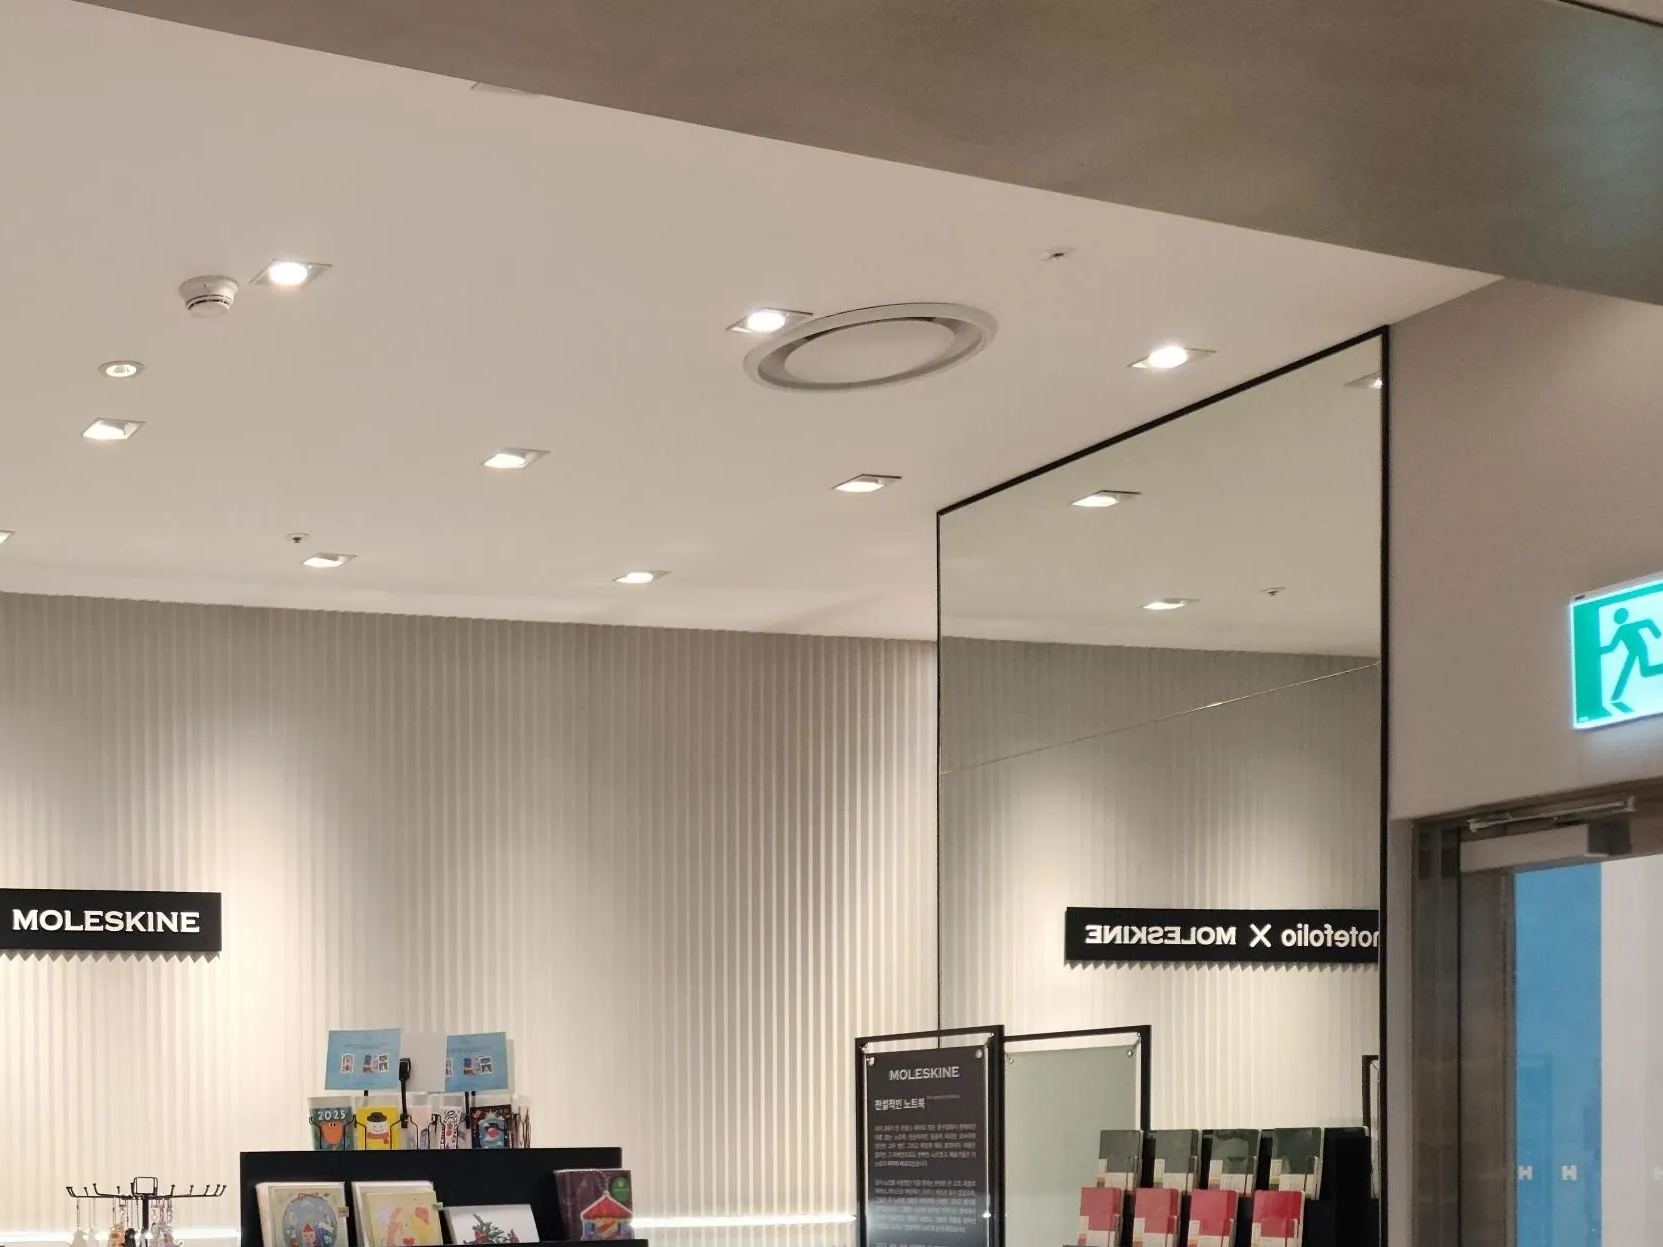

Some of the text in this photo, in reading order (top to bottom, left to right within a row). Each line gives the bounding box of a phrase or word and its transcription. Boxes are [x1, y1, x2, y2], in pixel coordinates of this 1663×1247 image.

[12, 909, 200, 933] MOLESKINE
[889, 1066, 960, 1080] MOLESKINE
[904, 1097, 925, 1110] 노트북
[317, 1109, 346, 1121] 2025
